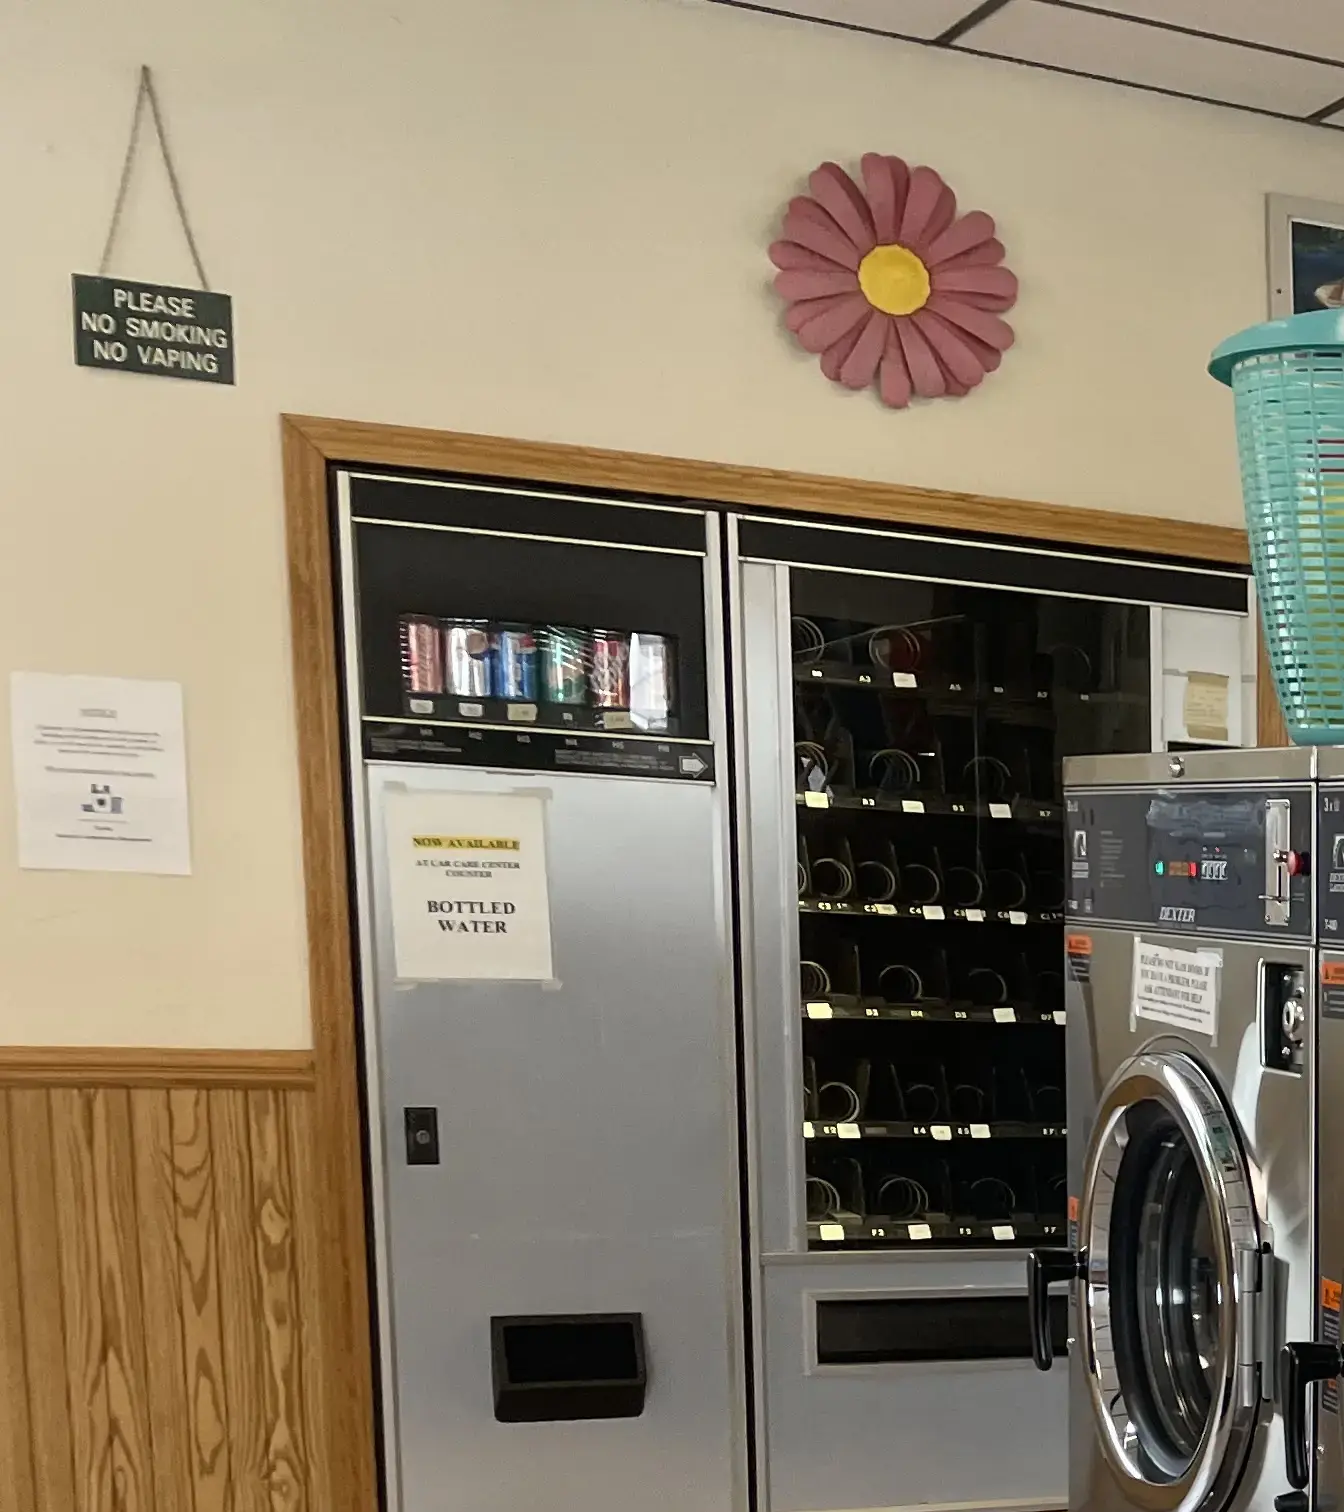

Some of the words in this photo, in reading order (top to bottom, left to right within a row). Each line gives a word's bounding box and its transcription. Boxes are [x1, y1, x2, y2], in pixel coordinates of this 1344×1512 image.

[113, 288, 196, 319] PLEASE
[81, 311, 116, 335] NO
[125, 317, 228, 349] SMOKING
[93, 339, 127, 363] NO
[137, 345, 219, 374] VAPING
[412, 837, 442, 848] NOW
[449, 839, 520, 851] AVAILABLE
[416, 859, 429, 867] AT
[430, 860, 451, 868] CAR
[453, 860, 479, 868] CARE
[481, 861, 521, 869] CENTER
[445, 869, 492, 878] COUNTER
[427, 900, 516, 915] BOTTLED
[438, 919, 508, 934] WATER
